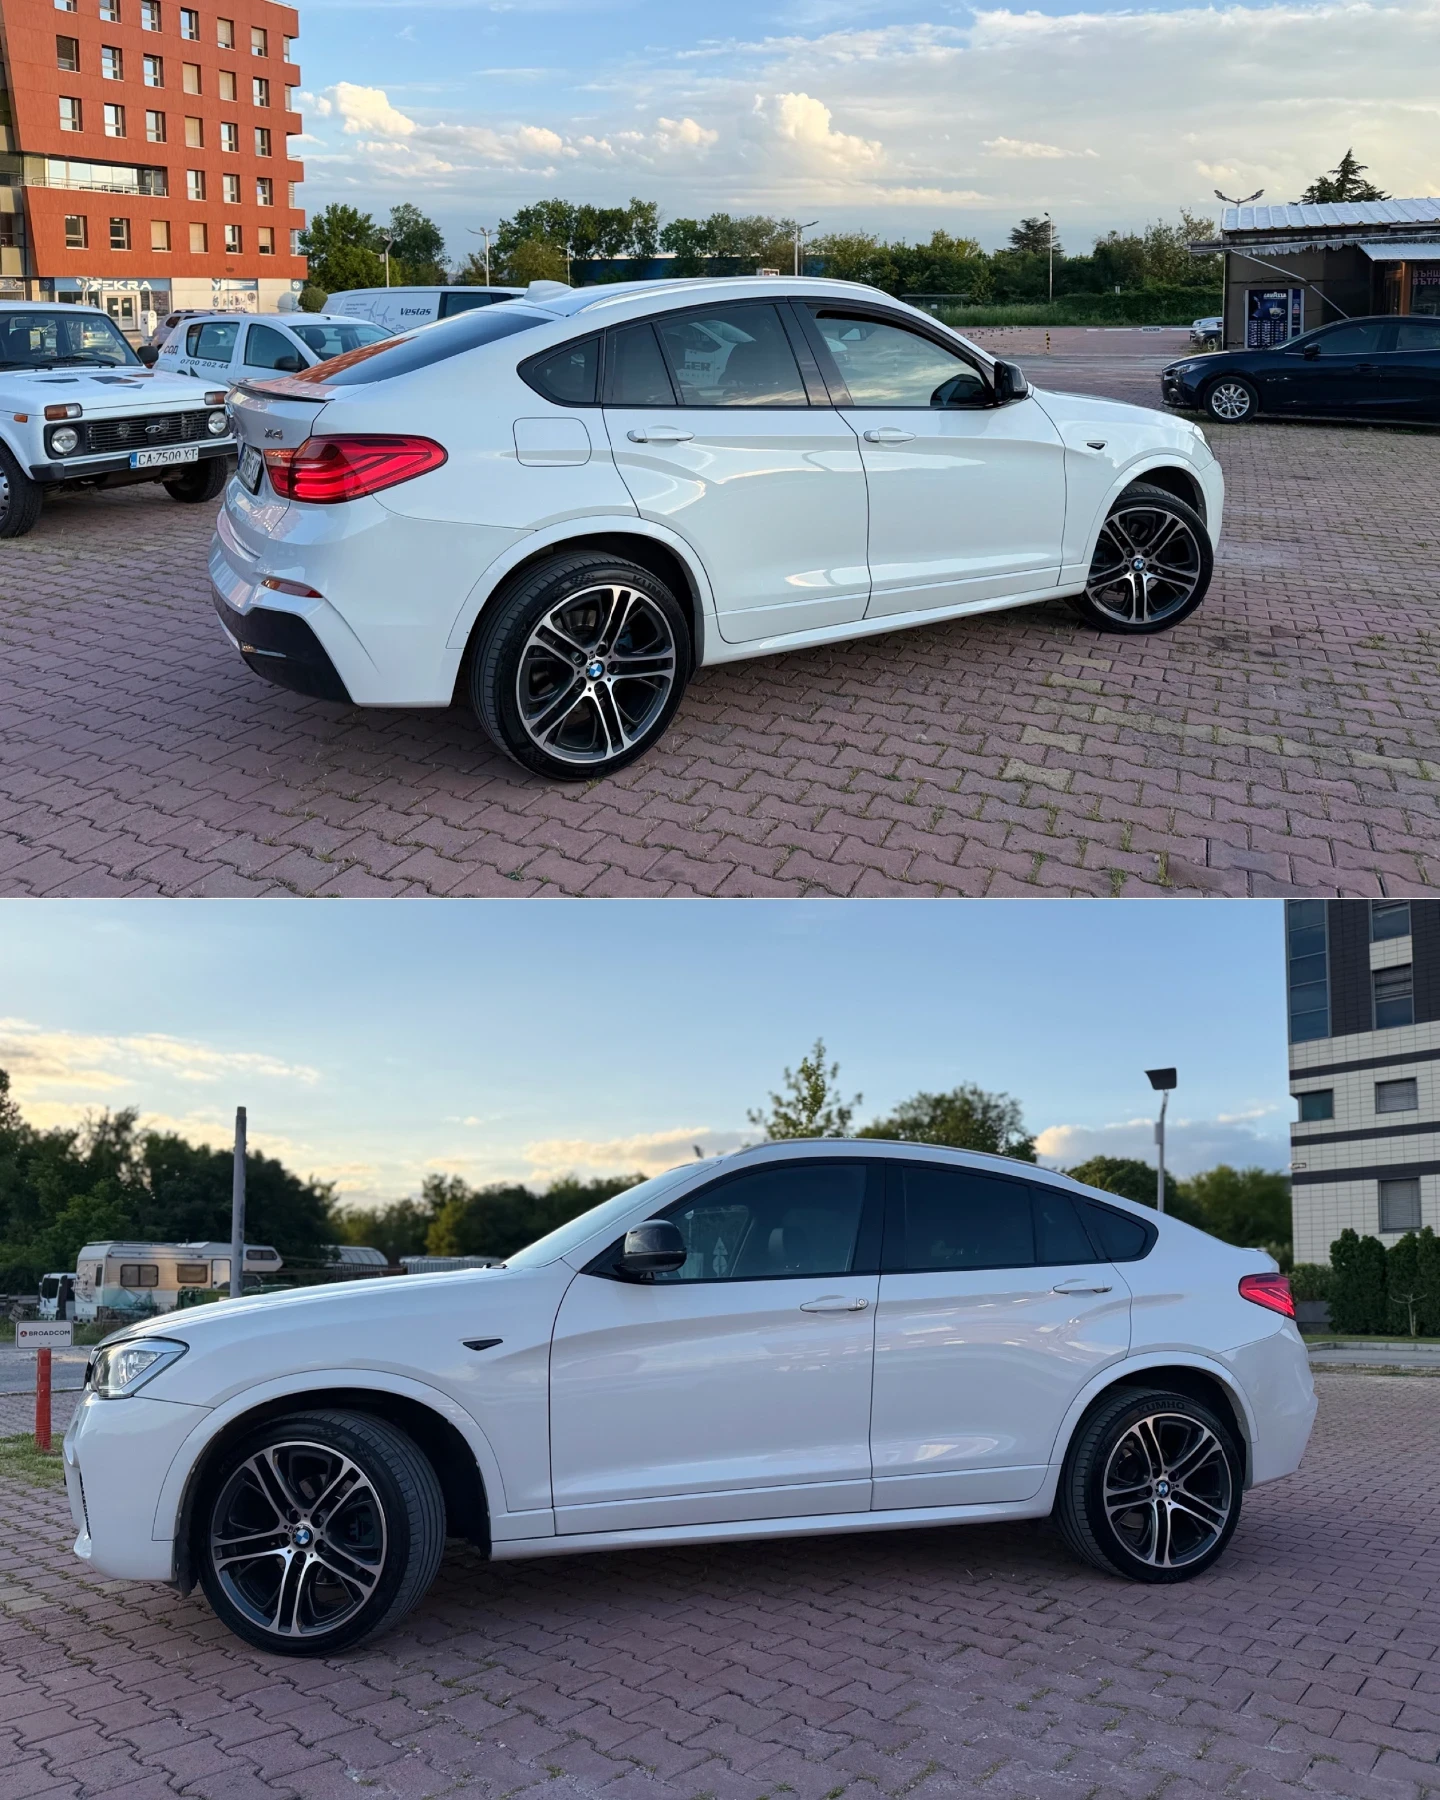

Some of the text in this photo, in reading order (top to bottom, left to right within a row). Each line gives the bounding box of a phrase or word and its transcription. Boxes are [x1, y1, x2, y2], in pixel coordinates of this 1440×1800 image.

[400, 307, 432, 315] Vestas
[264, 427, 283, 440] X4
[1137, 1401, 1185, 1415] KUMHO
